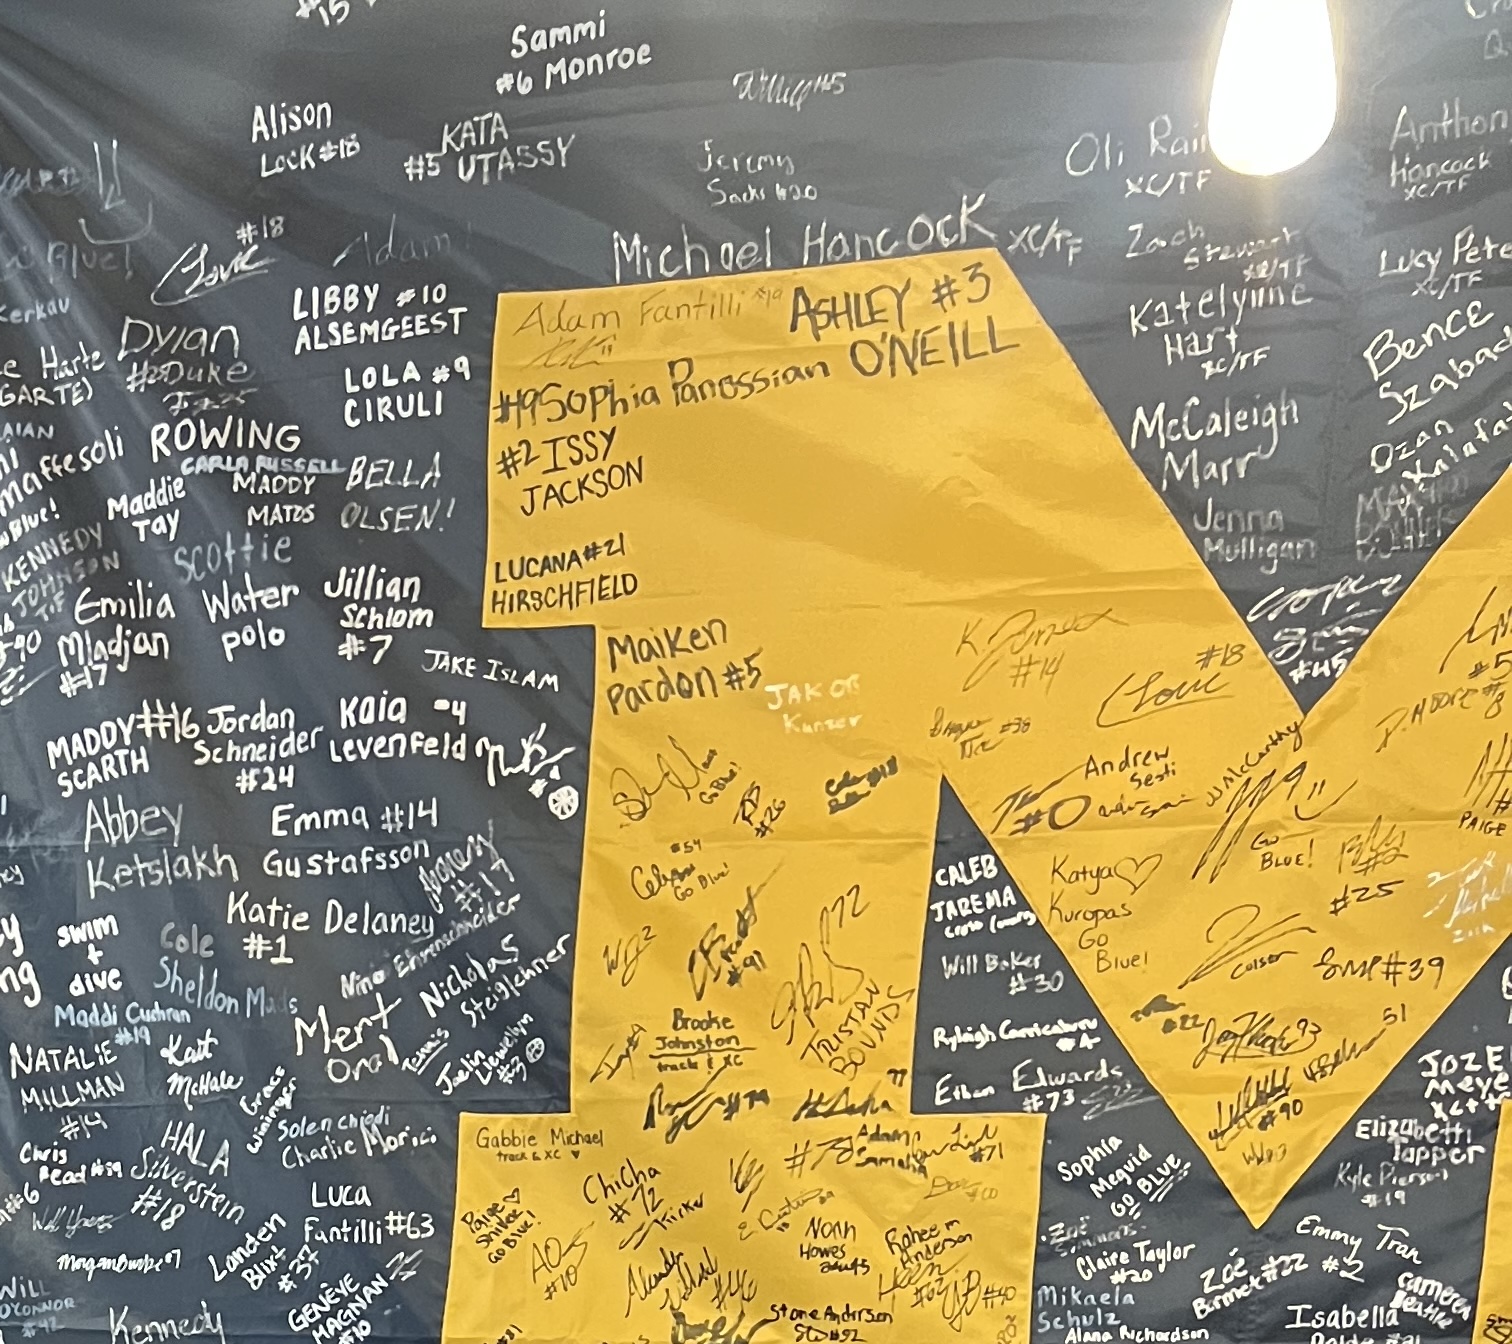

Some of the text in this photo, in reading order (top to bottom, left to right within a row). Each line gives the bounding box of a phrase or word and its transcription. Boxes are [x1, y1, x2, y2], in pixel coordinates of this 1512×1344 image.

[510, 9, 606, 59] Sammi
[495, 43, 652, 95] #6 Monroe
[251, 101, 332, 143] Alison
[442, 111, 509, 154] KATA
[457, 133, 576, 185] UTASSY
[612, 222, 772, 284] Michael
[292, 283, 447, 321] LIBBY #10
[510, 296, 743, 339] Adam Fantilli
[788, 261, 992, 343] ASHLEY #3
[293, 306, 469, 356] ALSEMGEEST
[849, 313, 1022, 380] O'NEILL
[40, 340, 107, 381] Harte
[344, 355, 472, 394] LOLA #9
[343, 389, 443, 428] CIRULI
[149, 414, 302, 464] ROWING
[495, 425, 618, 480] #2 ISSY
[232, 473, 318, 495] MADDY
[344, 451, 442, 492] BELLA
[520, 454, 645, 517] JACKSON
[106, 475, 187, 521] Maddie
[322, 564, 423, 604] Jillian
[493, 548, 583, 586] LUCANA
[73, 578, 177, 626] Emilia
[200, 571, 301, 624] Water
[489, 570, 639, 617] HIRSCHFIELD
[220, 618, 286, 663] polo
[337, 634, 394, 665] #7
[605, 617, 729, 674] Maiken
[420, 648, 477, 679] JAKE
[605, 665, 719, 716] Pardon
[206, 697, 296, 737] Jordan
[46, 712, 136, 770] MADDY
[56, 745, 151, 799] SCARTH
[270, 796, 439, 837] Emma #14
[262, 837, 432, 879] Gustafsson
[934, 852, 999, 887] CALEB
[56, 913, 120, 949] swim
[225, 889, 436, 945] Katie Delaney
[68, 966, 124, 997] dive
[8, 1039, 119, 1080] NATALIE
[19, 1069, 126, 1115] MILLMAN
[475, 1126, 604, 1149] Gabbie Michael
[1056, 1135, 1124, 1182] Sophia
[303, 1210, 436, 1246] Fantilli #63
[1075, 1239, 1197, 1282] Claire Taylor
[1284, 1303, 1401, 1330] Isabella
